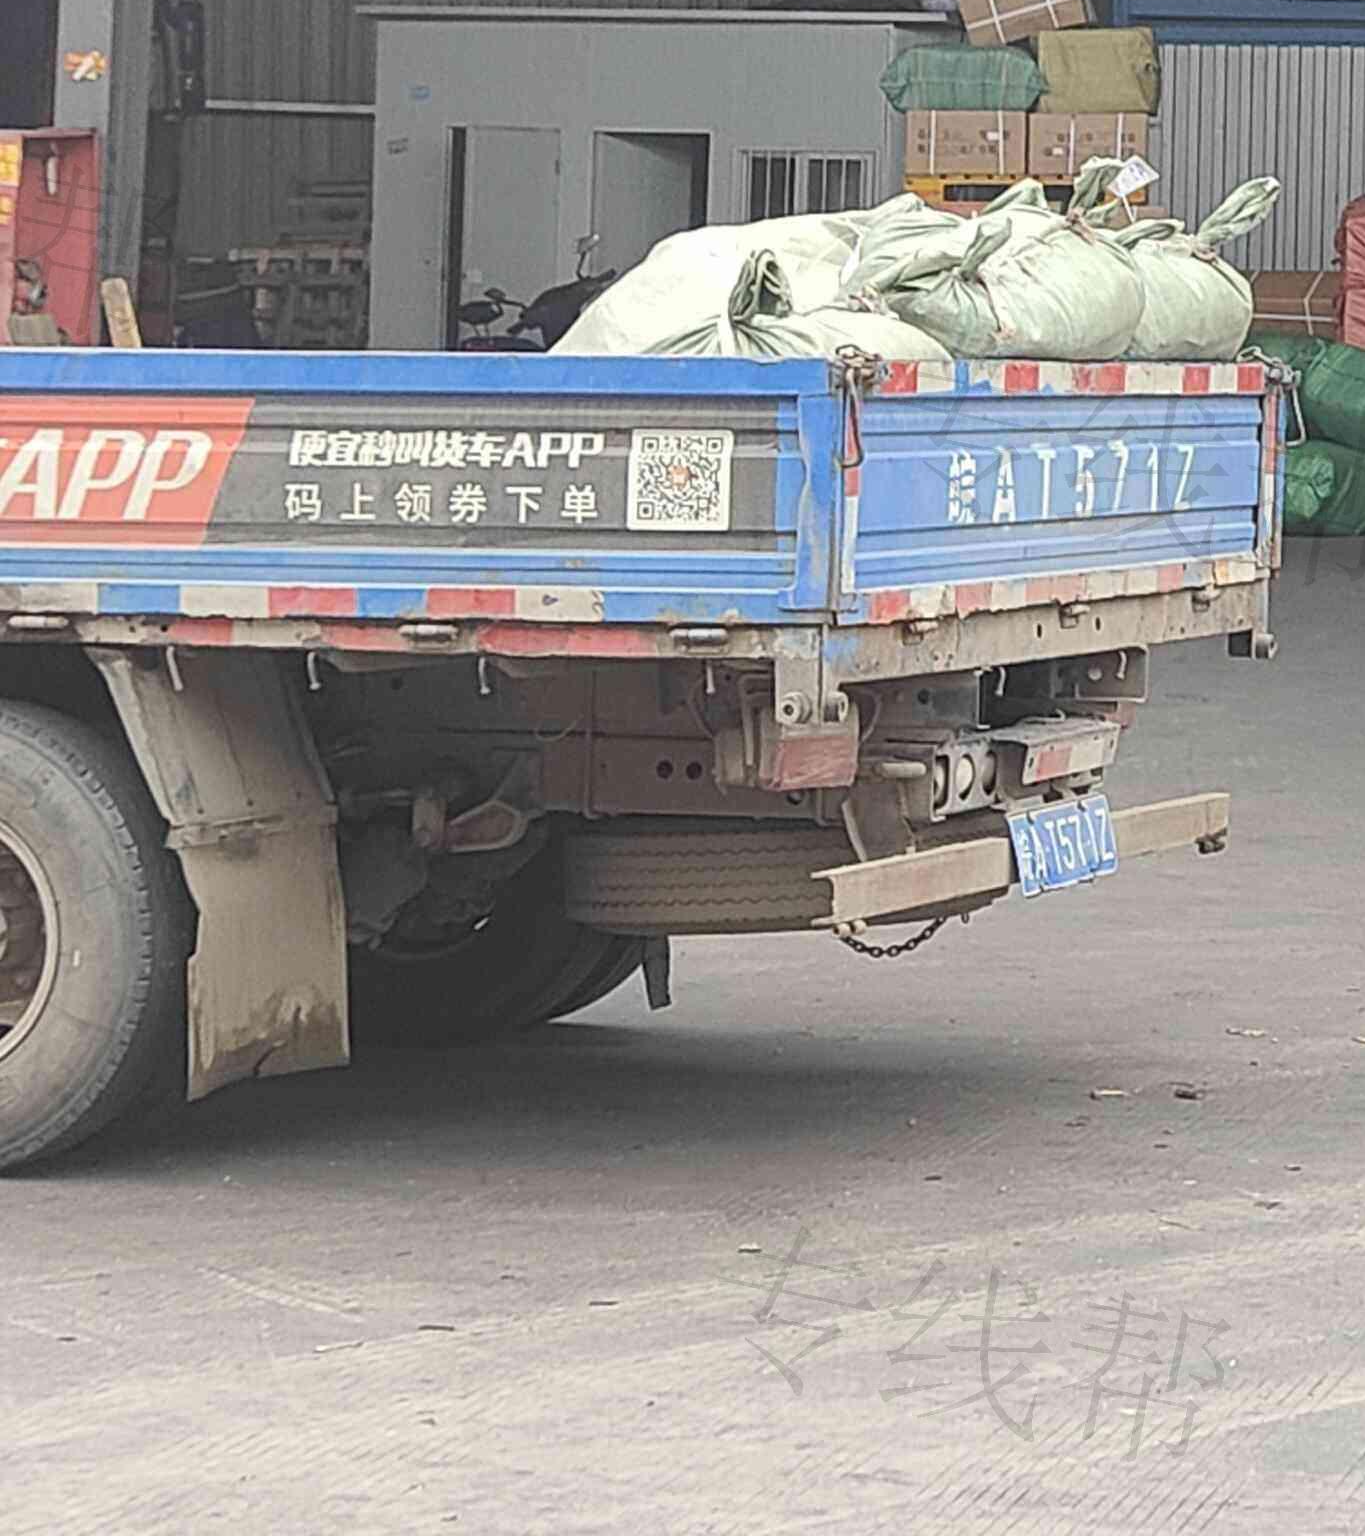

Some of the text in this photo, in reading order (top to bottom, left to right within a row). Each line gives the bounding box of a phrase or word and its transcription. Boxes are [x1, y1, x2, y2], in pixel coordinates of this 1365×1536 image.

[285, 482, 599, 524] 码上领券下单
